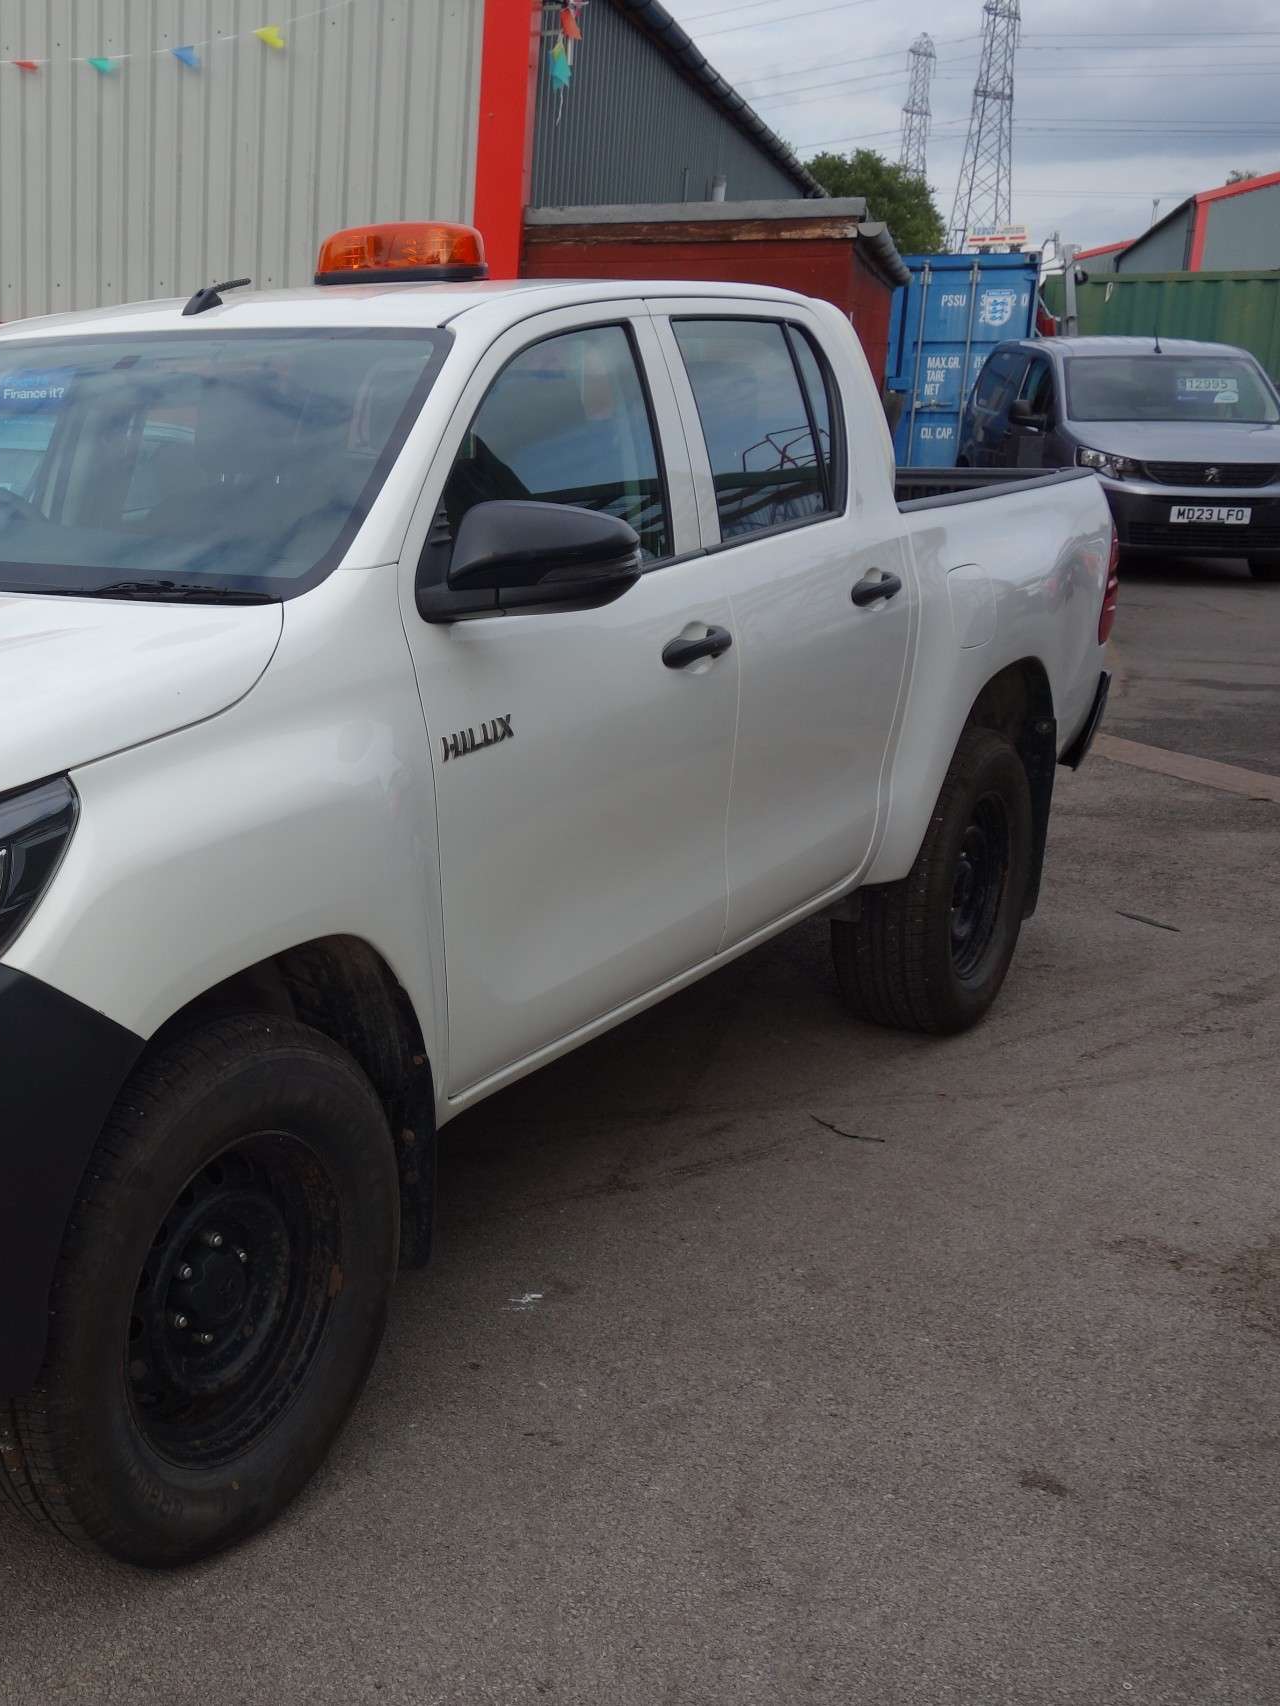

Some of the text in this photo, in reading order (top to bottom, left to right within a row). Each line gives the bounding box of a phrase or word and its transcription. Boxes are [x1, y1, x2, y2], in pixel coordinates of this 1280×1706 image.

[941, 294, 967, 306] PSSU
[927, 357, 961, 368] MAX.GR.
[927, 370, 945, 382] TARE
[3, 388, 47, 399] Finance
[48, 386, 65, 398] it?
[924, 383, 940, 395] NET
[921, 427, 953, 439] CU. CAP.
[441, 714, 514, 763] HILUX
